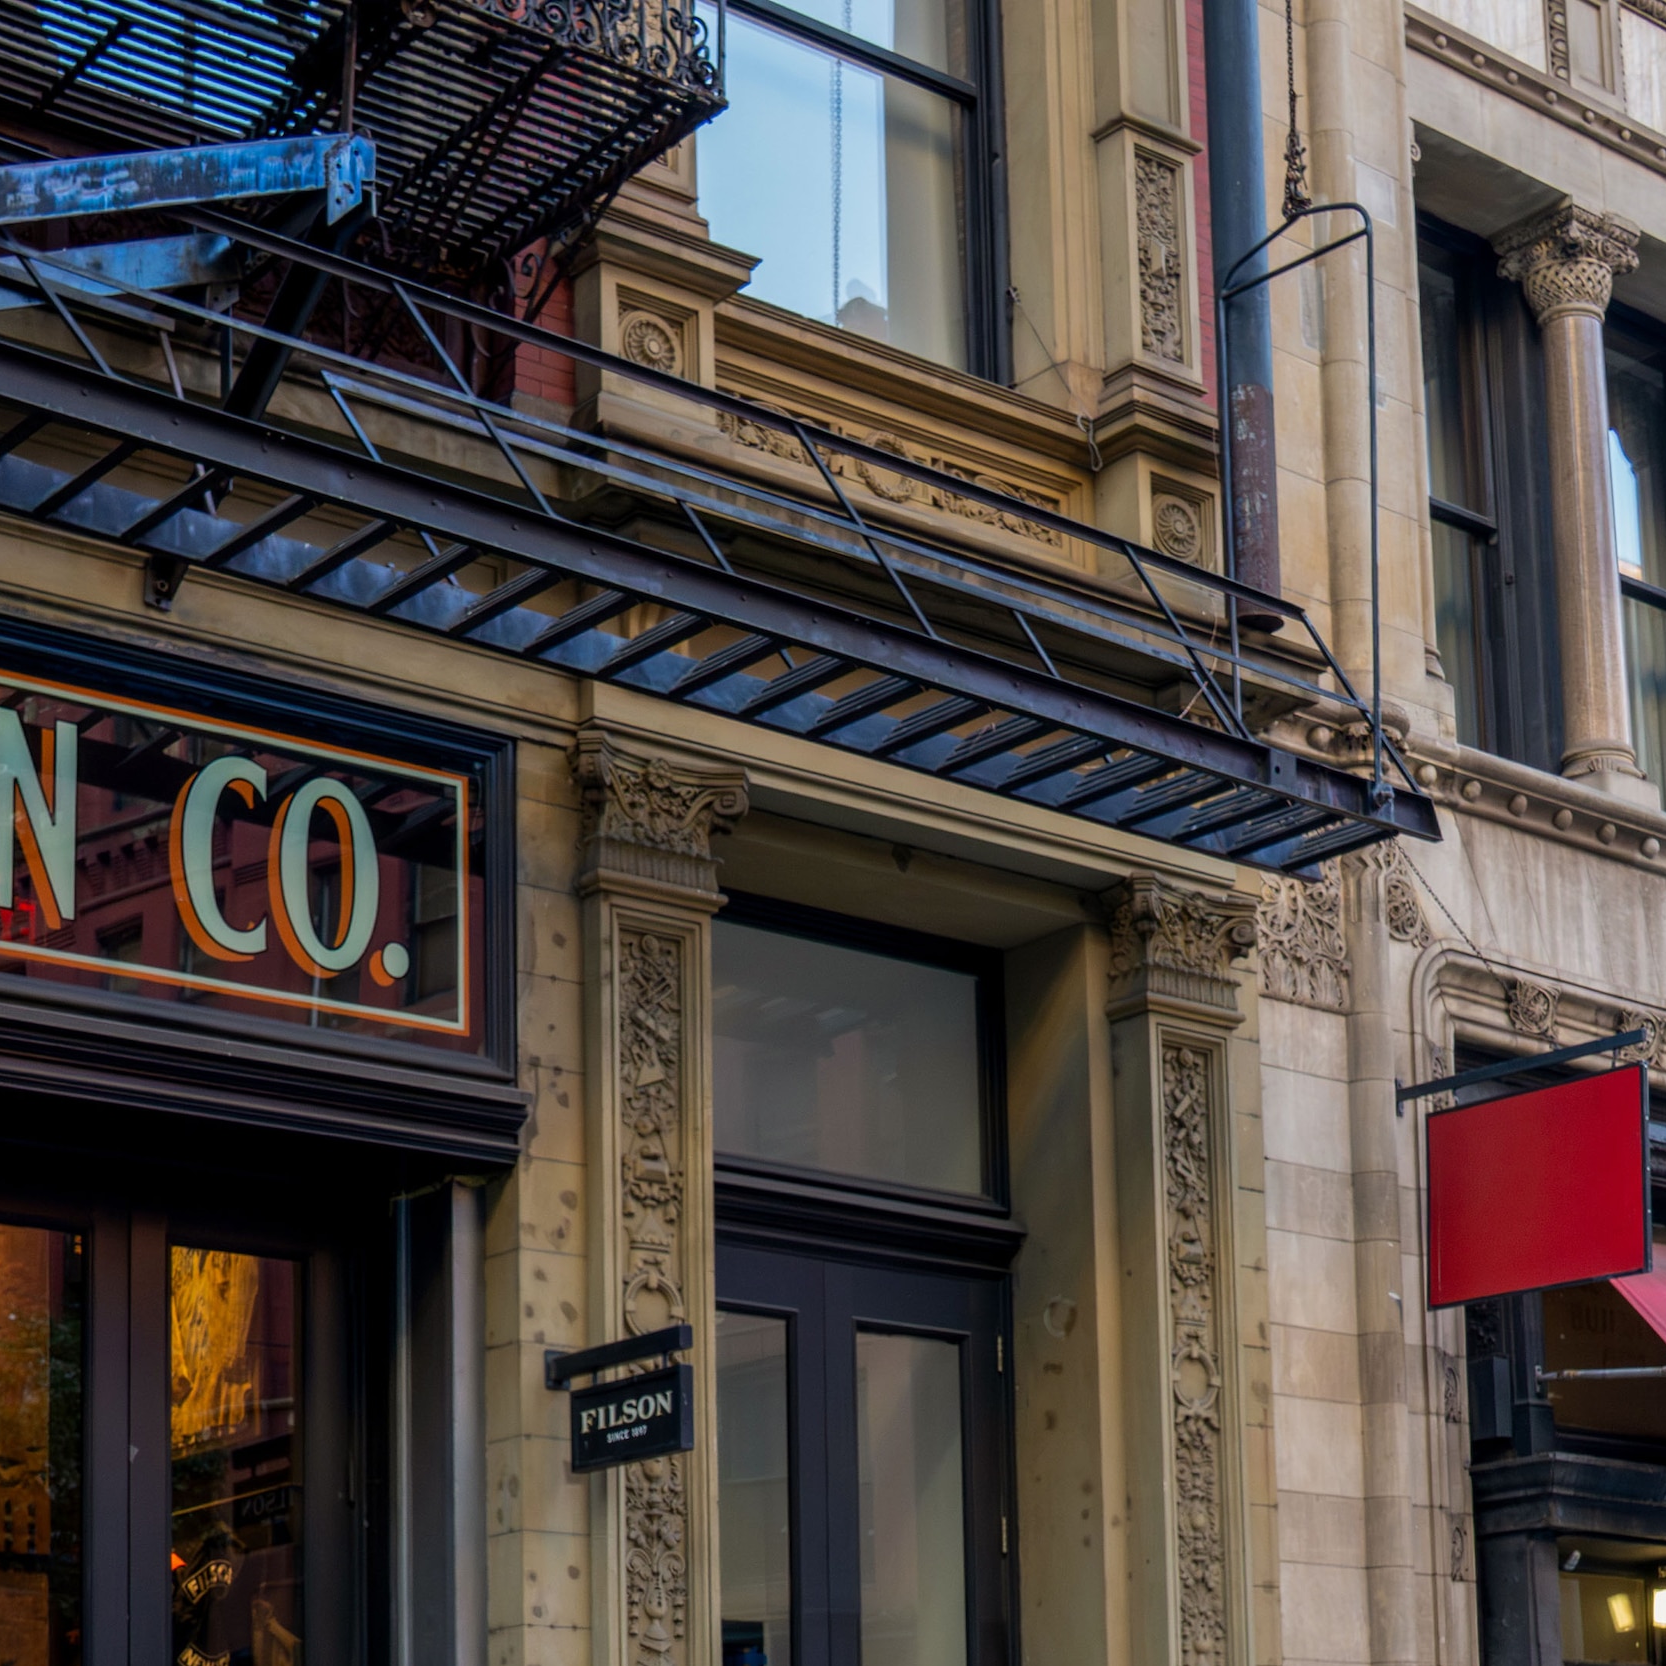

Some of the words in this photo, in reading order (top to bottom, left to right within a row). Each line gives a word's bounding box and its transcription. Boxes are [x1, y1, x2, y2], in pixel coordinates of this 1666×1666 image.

[170, 756, 410, 986] CO.
[580, 1390, 673, 1434] FILSON
[606, 1429, 630, 1443] SINCE
